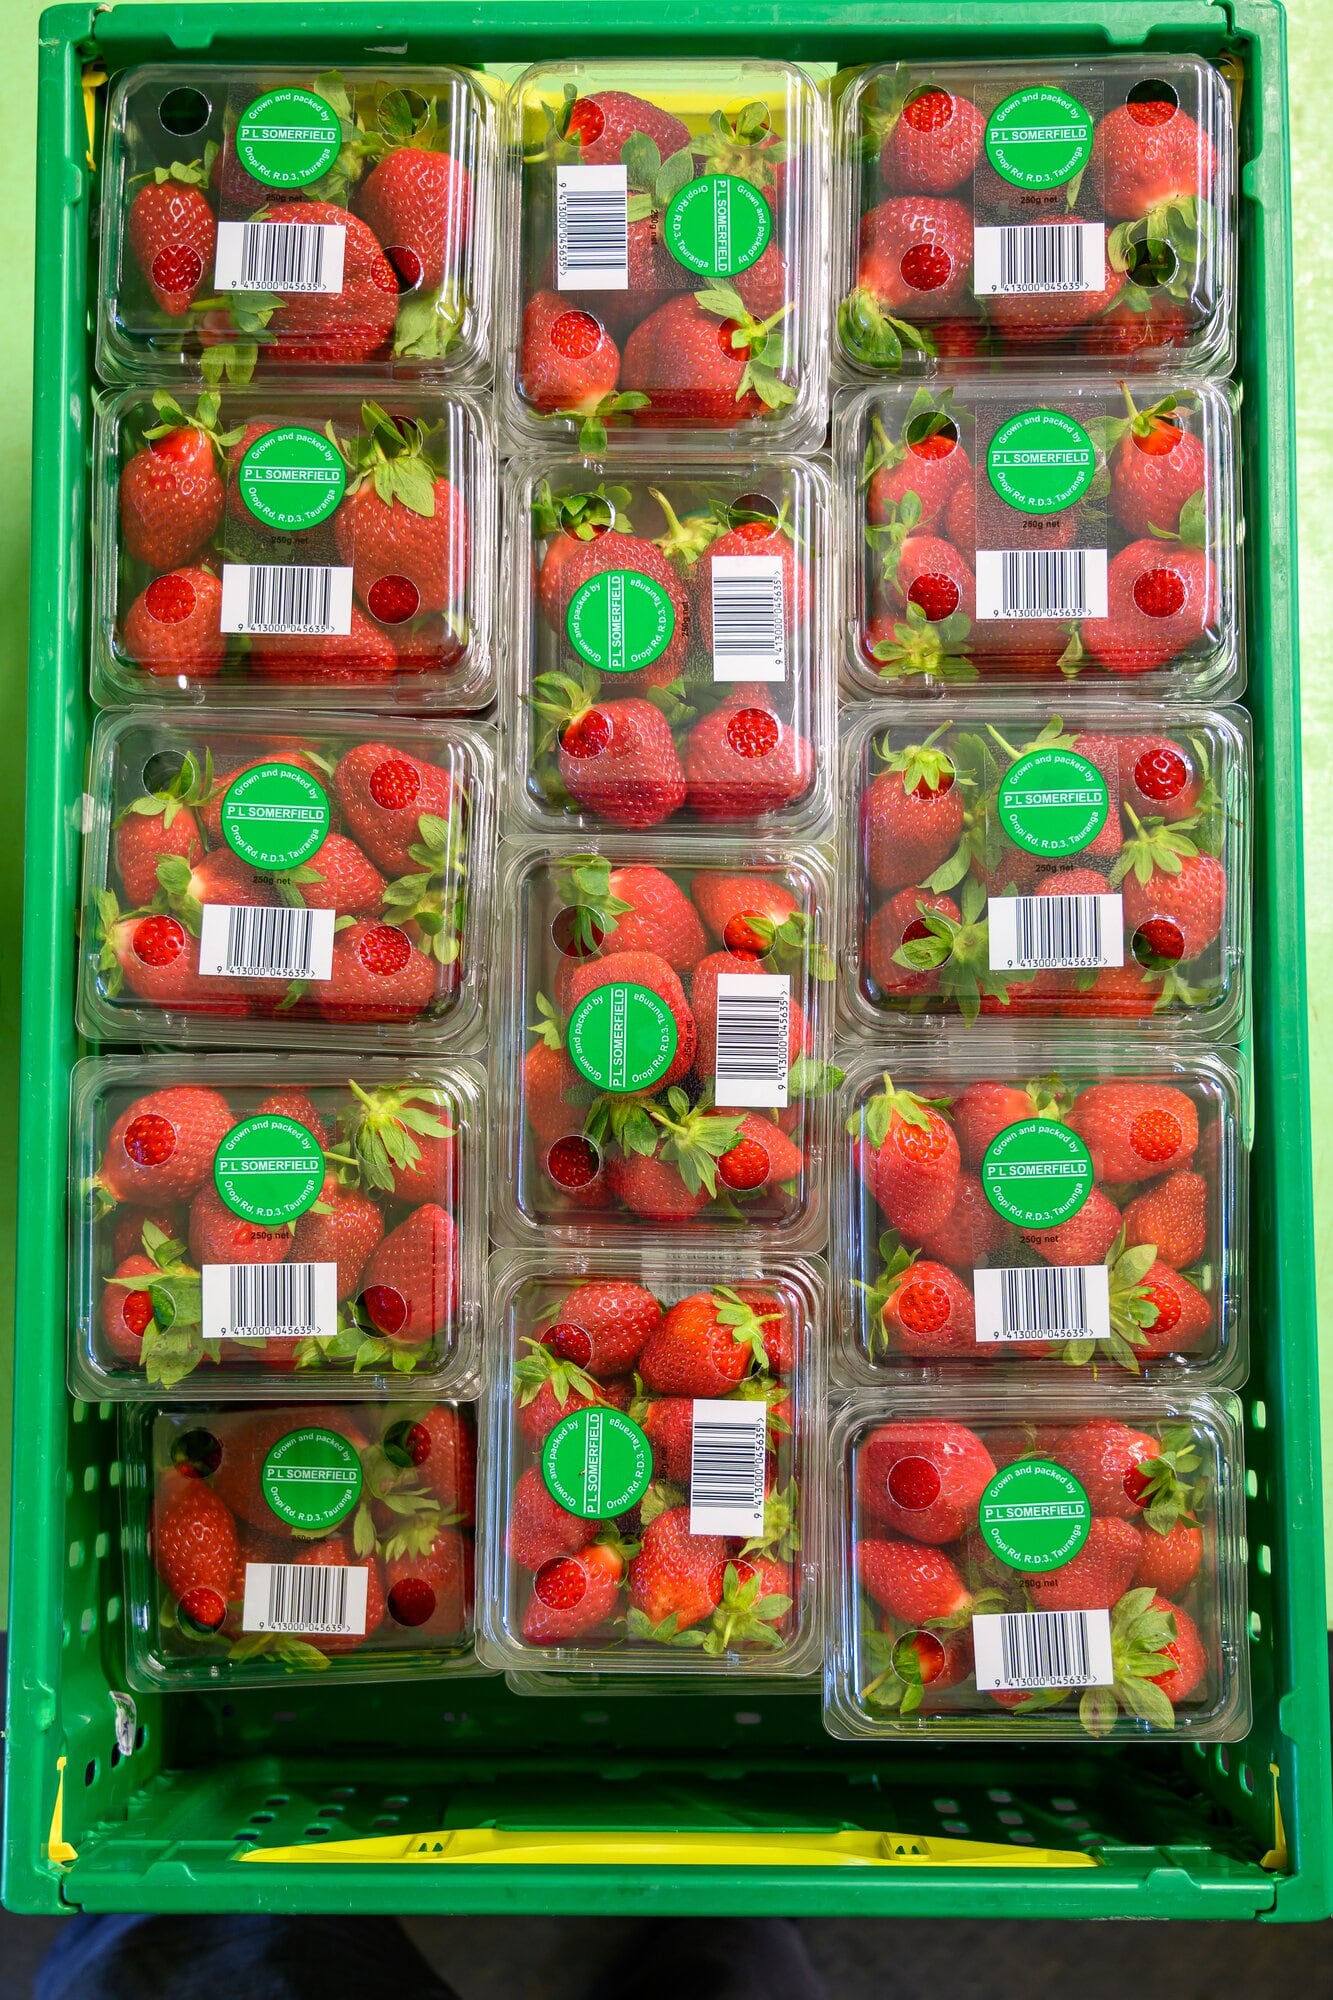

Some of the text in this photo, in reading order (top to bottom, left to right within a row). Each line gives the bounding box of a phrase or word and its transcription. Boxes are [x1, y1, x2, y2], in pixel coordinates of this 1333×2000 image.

[248, 93, 330, 121] Grown and packed by
[996, 92, 1080, 121] Grown and packed by
[261, 128, 335, 141] SOMERFIELD
[1011, 128, 1087, 140] SOMERFIELD
[244, 146, 262, 168] Oropi
[299, 148, 330, 177] Tauranga
[684, 184, 708, 203] Oropi
[1020, 195, 1058, 205] 250g net
[558, 194, 567, 229] 413000
[558, 232, 567, 267] 045635
[716, 199, 727, 271] SOMERFIELD
[677, 239, 709, 268] Tauranga
[991, 282, 1080, 293] 9 413000 045635
[251, 432, 334, 461] Grown and packed by
[1013, 452, 1089, 463] SOMERFIELD
[265, 469, 340, 481] SOMERFIELD
[997, 472, 1016, 495] Oropi
[1054, 471, 1085, 502] Tauranga
[248, 487, 267, 510] Oropi
[304, 489, 335, 519] Tauranga
[1022, 520, 1060, 529] 250g net
[611, 575, 622, 647] SOMERFIELD
[773, 579, 782, 614] 045635
[571, 582, 601, 662] Grown and packed by
[774, 617, 783, 653] 413000
[1009, 754, 1094, 784] Grown and packed by
[1025, 792, 1102, 804] SOMERFIELD
[248, 806, 324, 820] SOMERFIELD
[231, 824, 249, 849] Oropi
[287, 828, 319, 859] Tauranga
[252, 875, 291, 886] 250g net
[1007, 957, 1099, 968] 9 413000 045635
[633, 993, 665, 1025] Tauranga
[778, 999, 788, 1037] 045635
[612, 988, 625, 1065] SOMERFIELD
[683, 1019, 693, 1059] 250g net
[631, 1063, 656, 1082] Oropi
[777, 1040, 787, 1078] 413000
[225, 1120, 311, 1150] Grown and packed by
[241, 1160, 319, 1171] SOMERFIELD
[1009, 1163, 1087, 1176] SOMERFIELD
[224, 1180, 244, 1204] Oropi
[283, 1179, 314, 1212] Tauranga
[992, 1185, 1013, 1209] Oropi
[1052, 1182, 1083, 1215] Tauranga
[250, 1231, 289, 1241] 250g net
[1019, 1235, 1059, 1245] 250g net
[993, 1328, 1085, 1340] 9 413000 045635
[273, 1432, 351, 1461] Grown and packed by
[587, 1413, 600, 1491] SOMERFIELD
[754, 1426, 765, 1464] 045635
[286, 1468, 357, 1481] SOMERFIELD
[547, 1420, 578, 1506] Grown and packed by
[753, 1467, 764, 1506] 413000
[989, 1465, 1076, 1497] Grown and packed by
[1006, 1504, 1084, 1518] SOMERFIELD
[990, 1528, 1011, 1552] Oropi
[1051, 1524, 1081, 1558] Tauranga
[258, 1621, 342, 1633] 9 413000 045635
